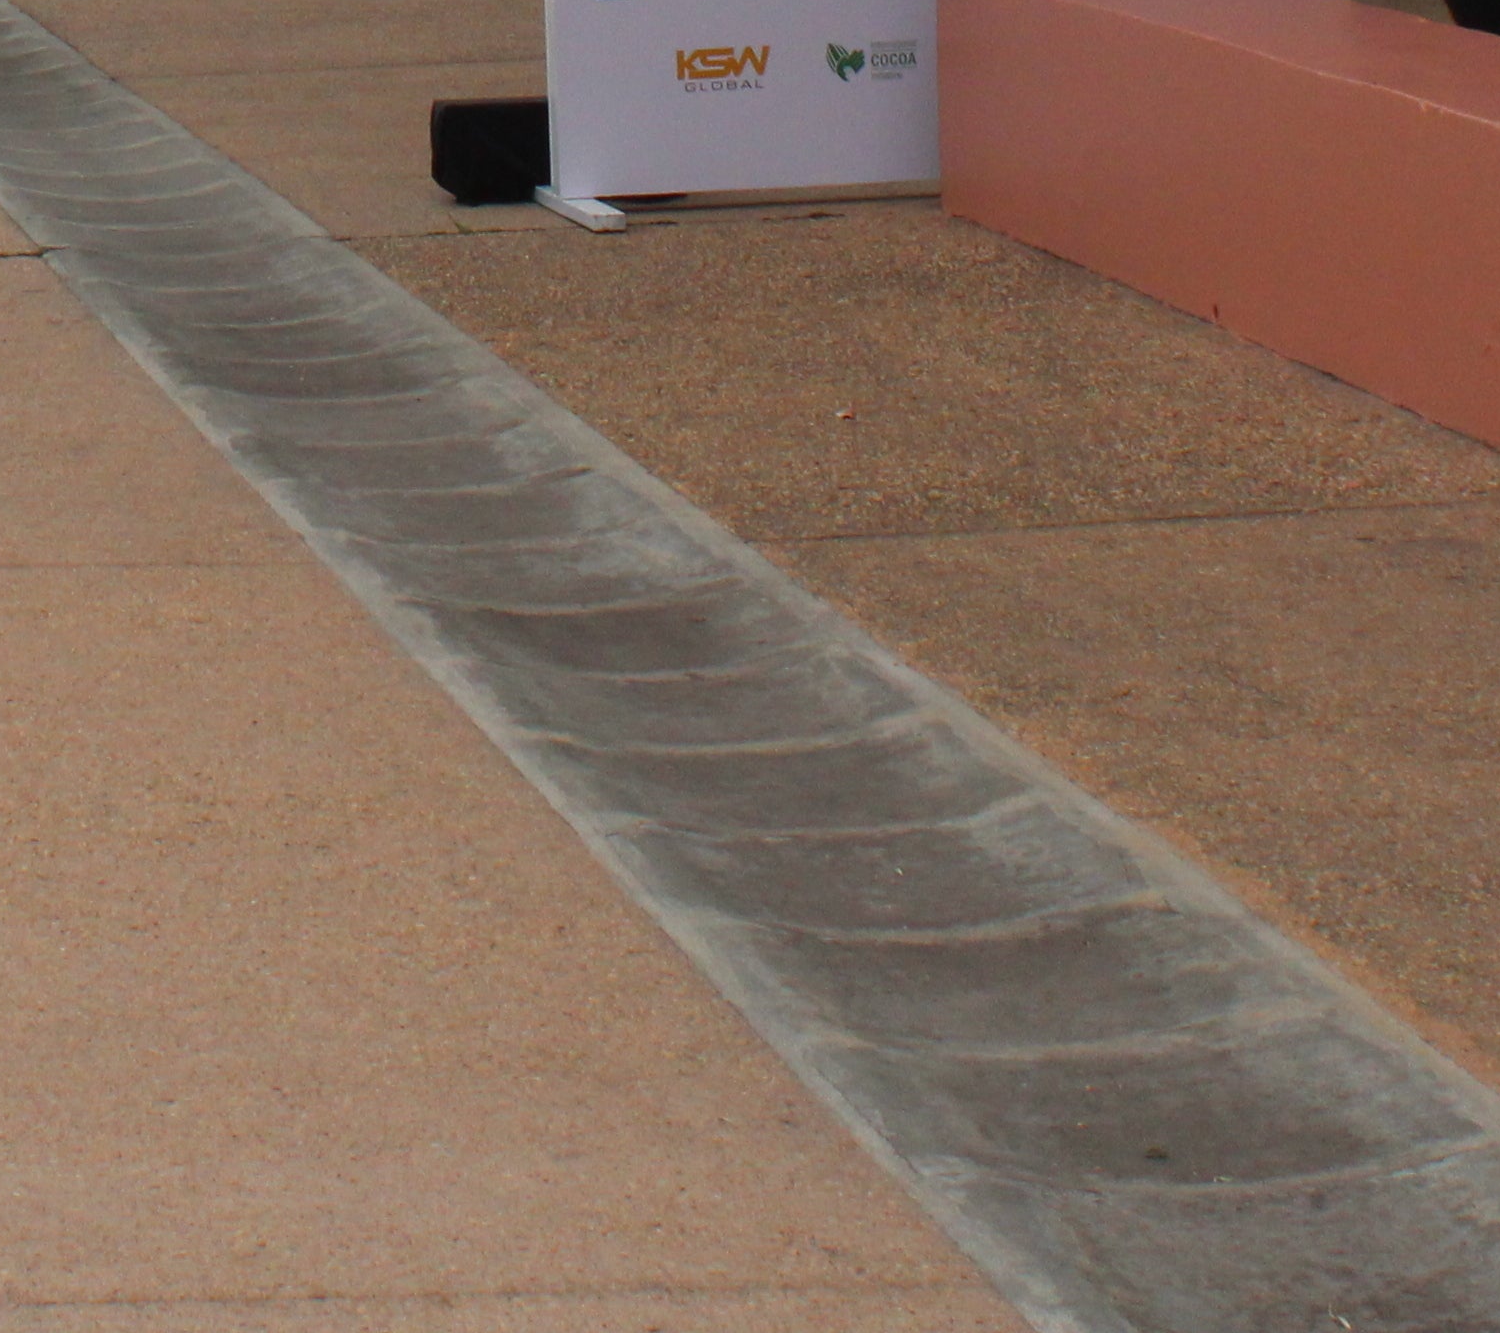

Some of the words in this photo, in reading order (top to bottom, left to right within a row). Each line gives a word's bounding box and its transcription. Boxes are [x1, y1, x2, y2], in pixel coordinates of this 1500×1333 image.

[676, 45, 770, 81] KSW
[871, 52, 917, 67] COCOA
[684, 80, 764, 93] GLOBAL
